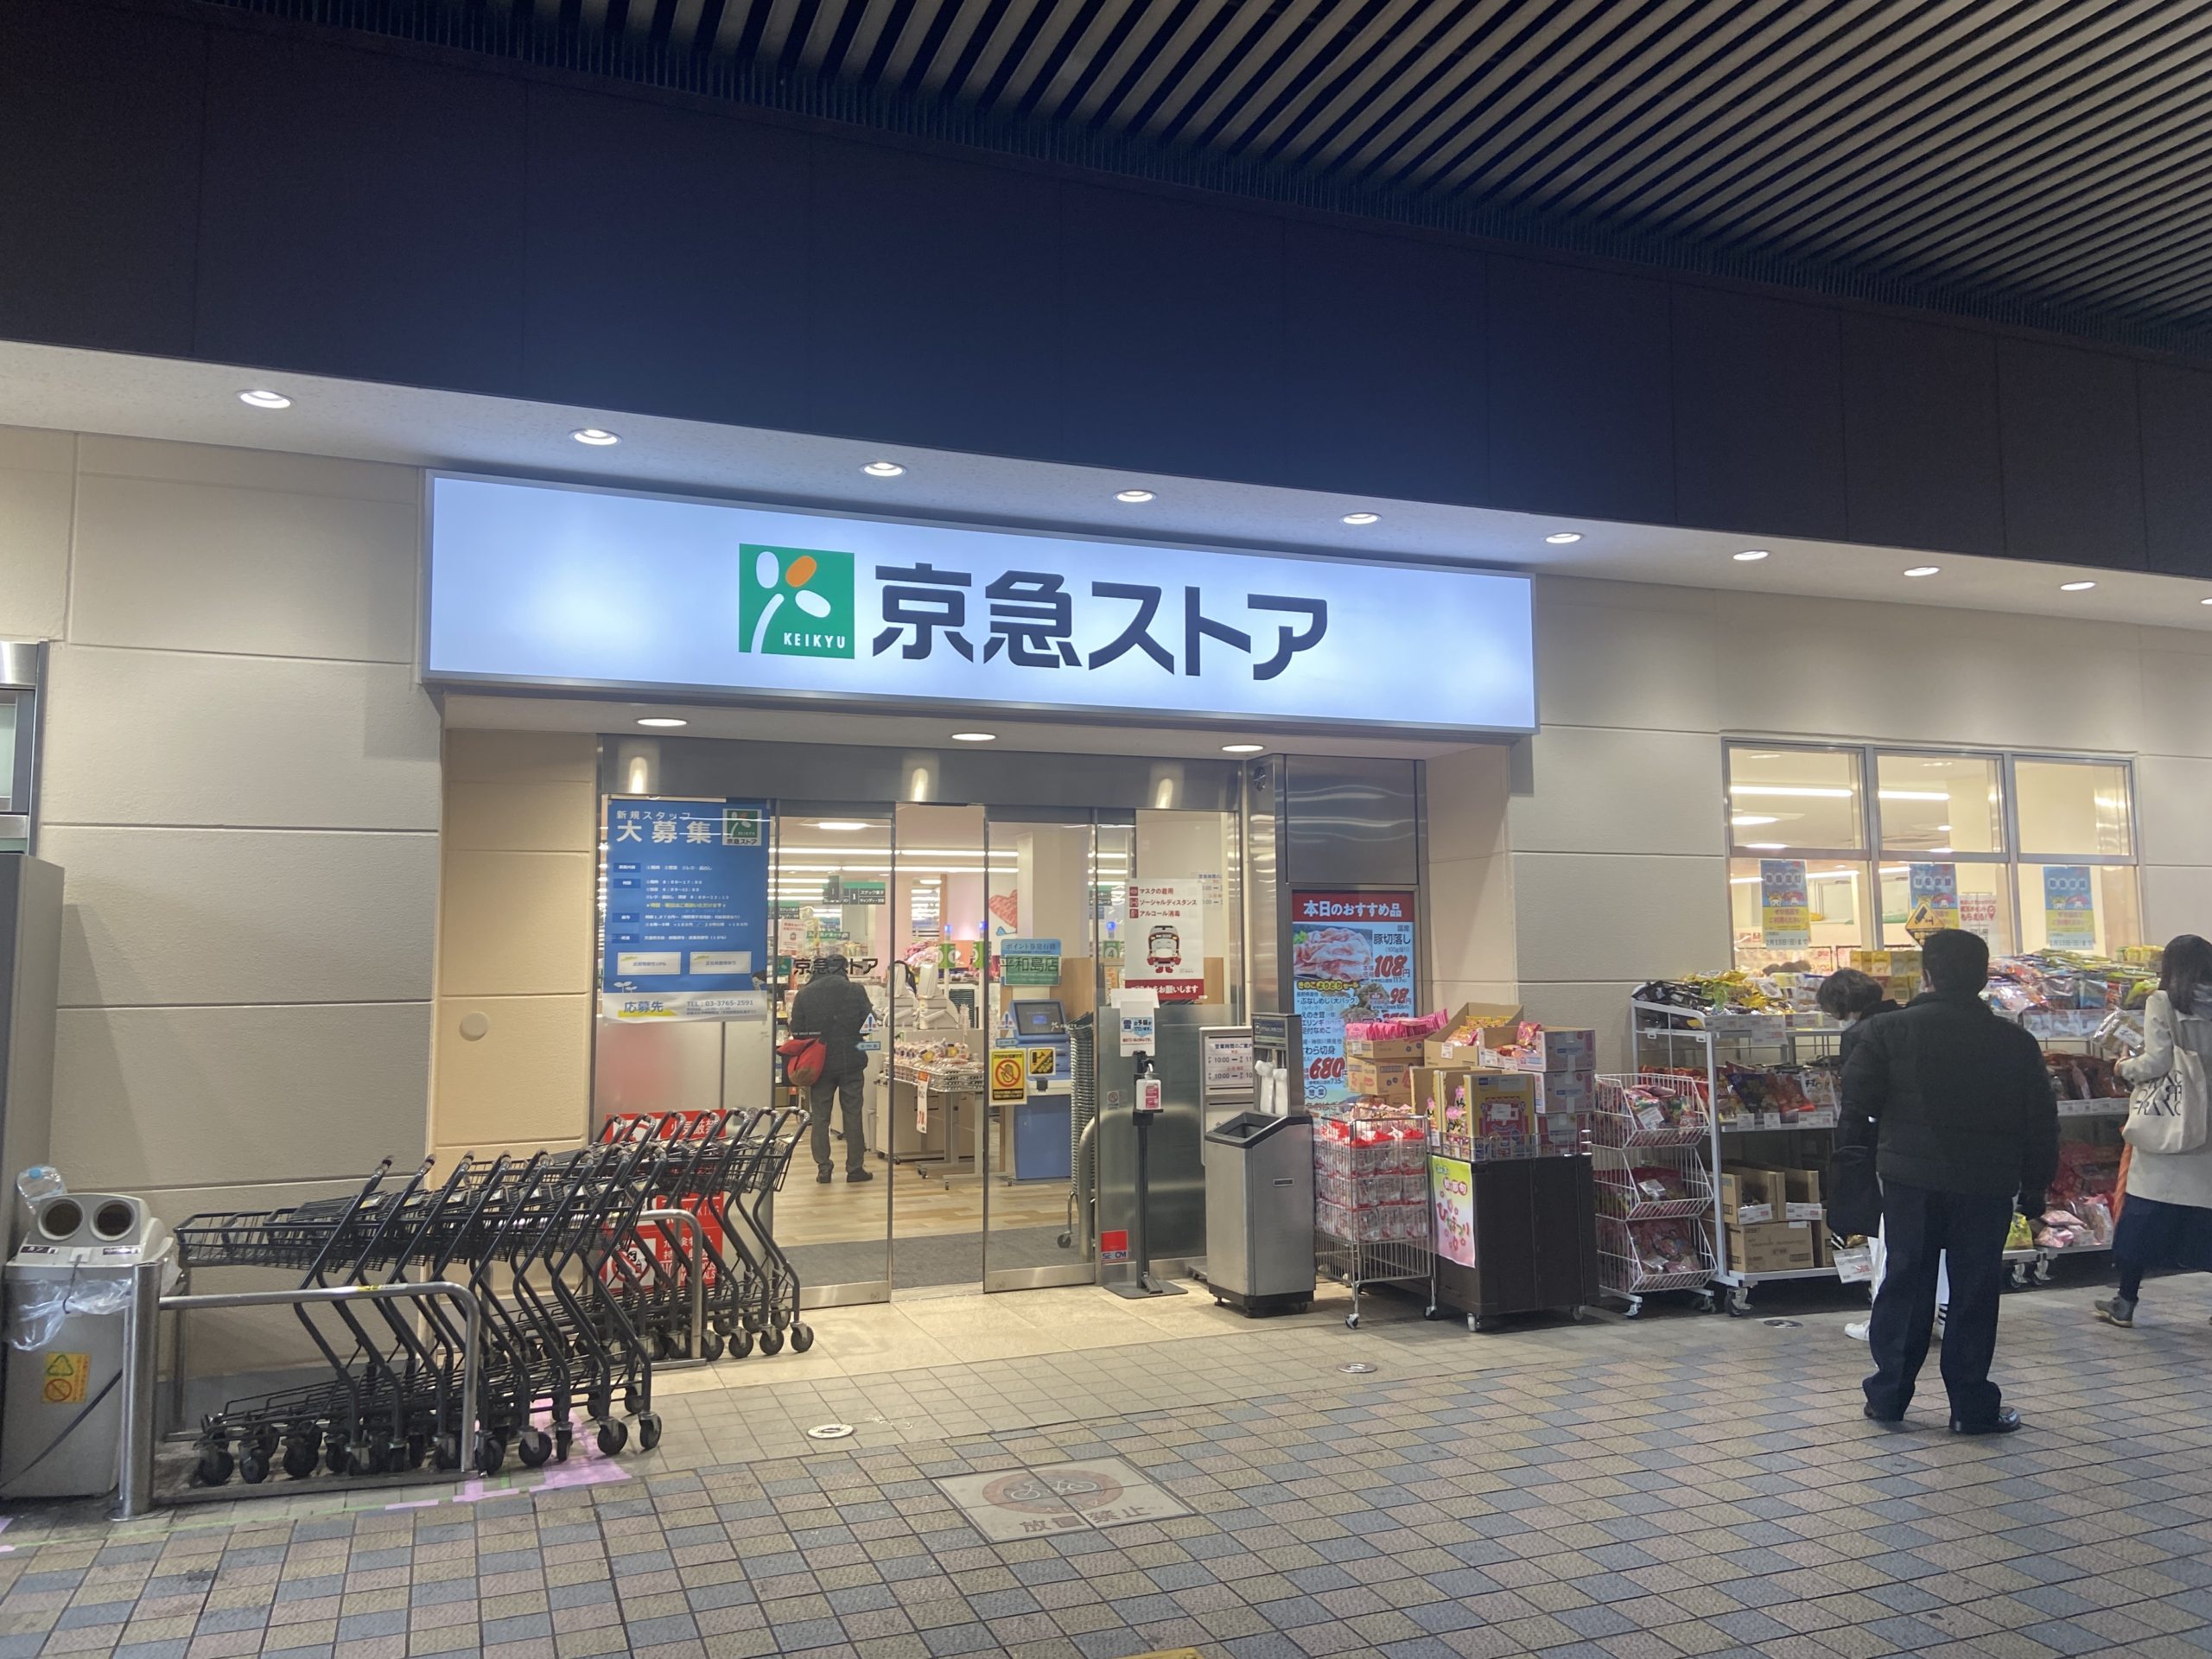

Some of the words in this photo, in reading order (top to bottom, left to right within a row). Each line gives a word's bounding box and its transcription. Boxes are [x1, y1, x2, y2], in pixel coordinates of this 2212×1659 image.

[873, 563, 1328, 681] 京急ストア
[783, 632, 846, 649] KEIKYU
[616, 820, 712, 844] 大募集
[1139, 887, 1174, 895] マスクの着用
[1303, 899, 1402, 918] 本日のおすすめ品
[1373, 933, 1411, 945] 豚切落し
[624, 1001, 664, 1014] 応募先
